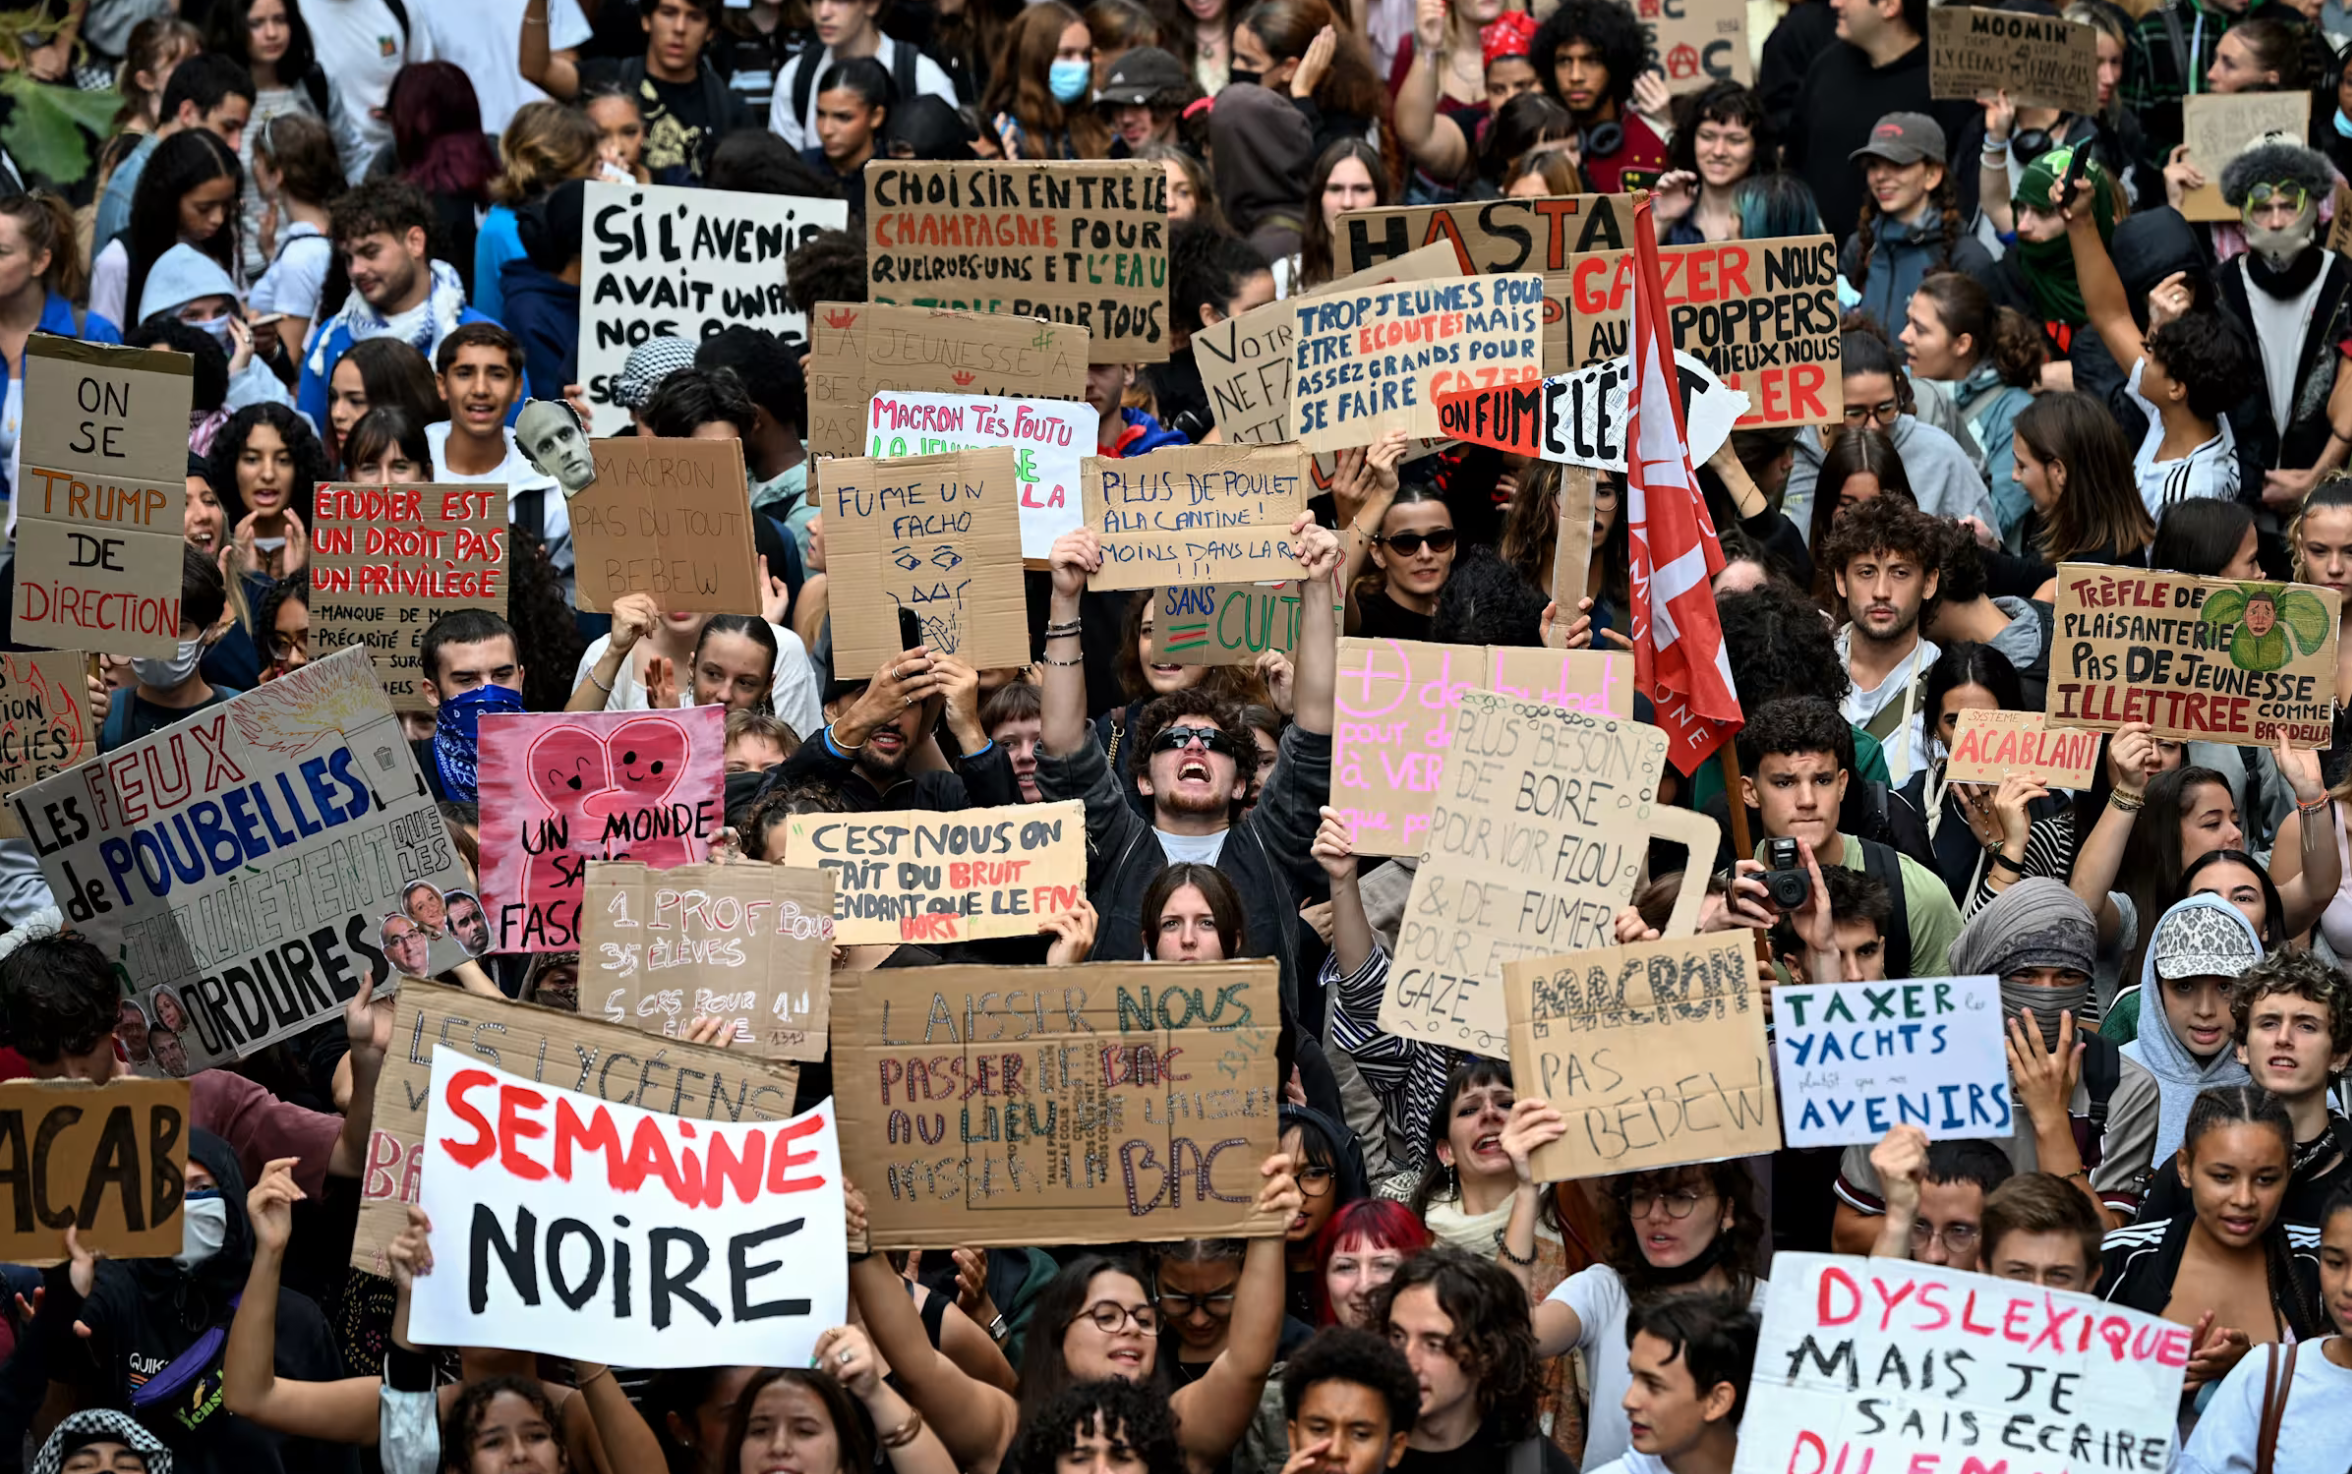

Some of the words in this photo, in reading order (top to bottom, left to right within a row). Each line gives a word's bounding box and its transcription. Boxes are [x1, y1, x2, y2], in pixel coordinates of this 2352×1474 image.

[1971, 15, 2067, 43] MOOMIN
[1029, 174, 1137, 209] ENTRE
[876, 213, 1058, 248] CHAMPAGNE
[1071, 218, 1162, 249] POUR
[1347, 195, 1625, 275] HASTA
[1045, 252, 1082, 283] ET
[1088, 253, 1166, 288] L'EAU
[1573, 247, 1752, 316] GAZER
[1765, 242, 1837, 292] NOUS
[722, 287, 765, 320] UN
[1100, 300, 1162, 344] TOUS
[1297, 297, 1372, 337] TROP
[1375, 281, 1483, 317] JEUNES
[1494, 277, 1542, 306] POUR
[1672, 289, 1838, 348] POPPERS
[817, 328, 859, 358] LA
[876, 328, 1034, 374] JEUNESSE
[1199, 320, 1293, 364] VOTR
[1785, 336, 1840, 364] NOUS
[1297, 362, 1364, 398] ASSEZ
[1369, 343, 1460, 379] GRANDS
[1469, 338, 1534, 361] POUR
[77, 377, 130, 418] ON
[1213, 372, 1257, 423] NE
[1300, 401, 1328, 435] SE
[1441, 400, 1469, 433] ON
[69, 422, 126, 458] SE
[813, 416, 857, 442] PAS
[873, 398, 964, 432] MACRON
[1014, 405, 1072, 447] FOUTU
[594, 457, 714, 489] MACRON
[1102, 470, 1172, 504] PLUS
[1187, 472, 1220, 506] DE
[1225, 470, 1298, 497] POULET
[31, 468, 167, 526] TRUMP
[440, 490, 496, 521] EST
[838, 483, 926, 517] FUME
[940, 480, 984, 500] UN
[1021, 483, 1065, 508] LA
[573, 506, 627, 537] PAS
[638, 506, 670, 537] DU
[677, 508, 742, 537] TOUT
[893, 511, 972, 540] FACHO
[1122, 510, 1149, 530] LA
[66, 533, 125, 572] DE
[312, 529, 353, 555] UN
[454, 528, 504, 564] PAS
[1185, 540, 1243, 562] DANS
[1249, 540, 1269, 559] LA
[312, 567, 351, 594] UN
[605, 558, 718, 596] BEBEW
[2070, 576, 2170, 609] TRÈFLE
[2175, 588, 2206, 609] DE
[400, 608, 420, 623] DE
[1165, 585, 1216, 616] SANS
[2072, 642, 2118, 680] PAS
[2127, 646, 2174, 684] DE
[2175, 653, 2316, 701] JEUNESSE
[1968, 711, 2020, 722] SYSTEME
[2055, 683, 2250, 733] ILLETTREE
[2258, 703, 2330, 720] COMME
[1335, 721, 1408, 766] pour
[1453, 708, 1519, 758] PLUS
[1532, 722, 1641, 781] BESOIN
[1954, 728, 2102, 770] ACABLANT
[2255, 721, 2331, 742] BARDELLA
[14, 795, 90, 858] LES
[82, 713, 246, 832] FEUX
[1341, 750, 1371, 789] à
[1455, 759, 1505, 804] DE
[1514, 770, 1614, 827] BOIRE
[61, 860, 112, 923] de
[99, 745, 370, 906] POUBELLES
[391, 805, 443, 851] QUE
[522, 817, 568, 856] UN
[601, 800, 715, 845] MONDE
[812, 822, 910, 856] C'EST
[914, 821, 1014, 858] NOUS
[1020, 819, 1062, 850] ON
[1339, 807, 1393, 842] que
[1431, 805, 1492, 860] POUR
[1500, 821, 1550, 874] VOIR
[1553, 834, 1623, 887] FLOU
[396, 837, 452, 883] LES
[897, 862, 941, 890] DU
[608, 890, 638, 927] 1
[648, 889, 772, 936] PROF
[776, 901, 834, 940] POUR
[834, 891, 926, 922] ENDANT
[926, 891, 982, 917] QUE
[991, 888, 1031, 916] LE
[901, 912, 960, 941] DORT
[1418, 875, 1449, 917] &
[1457, 880, 1509, 928] DE
[1518, 889, 1612, 948] FUMER
[600, 942, 641, 977] 35
[1398, 921, 1472, 975] POUR
[185, 913, 391, 1056] ORDURES
[637, 989, 683, 1016] CRS
[693, 988, 755, 1016] POUR
[1397, 968, 1480, 1024] GAZÉ
[1784, 982, 1956, 1027] TAXER
[881, 984, 1096, 1046] LAISSER
[1115, 982, 1253, 1033] NOUS
[1784, 1024, 1947, 1066] YACHTS
[879, 1051, 1027, 1105] PASSER
[1039, 1045, 1083, 1094] LE
[1100, 1044, 1192, 1090] BAC
[1539, 1047, 1624, 1101] PAS
[887, 1109, 945, 1145] AU
[960, 1100, 1058, 1143] LIEU
[1585, 1056, 1766, 1161] BEBEW
[1799, 1083, 2010, 1133] AVENIRS
[0, 1104, 185, 1234] ACAB
[887, 1155, 1046, 1203] PASSER
[1065, 1154, 1104, 1190] LA
[1119, 1137, 1252, 1217] BAC
[1816, 1266, 2194, 1369] DYSLEXIQUE
[1784, 1334, 1977, 1399] MAIS
[2004, 1362, 2081, 1415] JE
[1855, 1397, 1981, 1446] SAIS
[2000, 1414, 2167, 1471] ECRIRE
